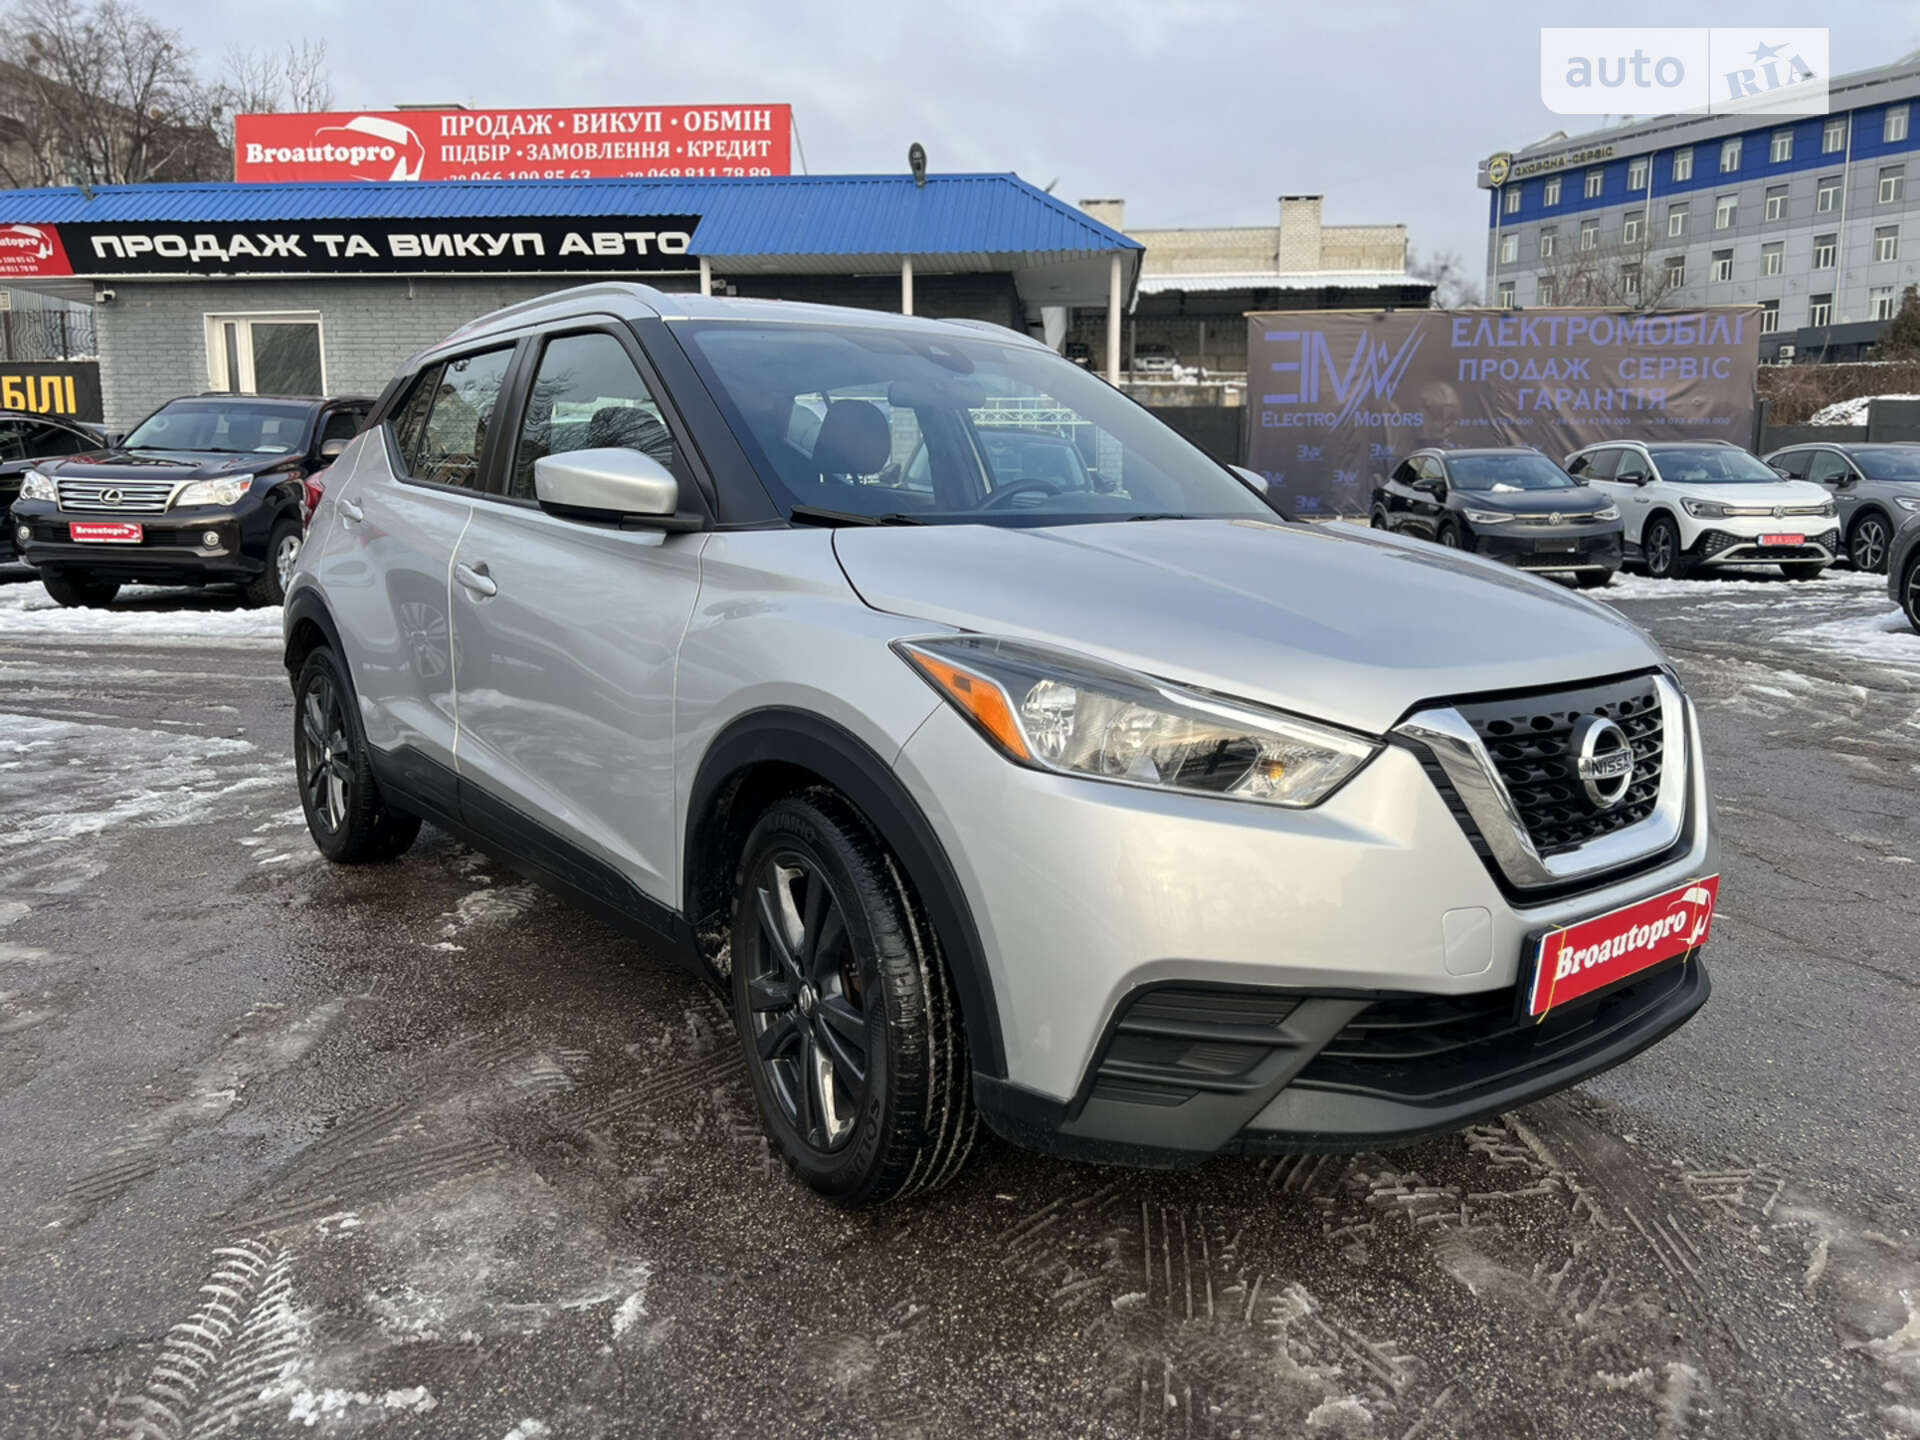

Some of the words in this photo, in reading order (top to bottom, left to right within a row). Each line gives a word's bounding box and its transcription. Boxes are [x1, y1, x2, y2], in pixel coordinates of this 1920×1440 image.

[440, 114, 553, 140] ПРОДАЖ
[572, 111, 662, 134] ВИКУП
[683, 110, 772, 133] ОБМІН
[245, 143, 396, 167] Broautopro
[440, 144, 511, 165] ПІДБІР
[526, 141, 670, 161] ЗАМОВЛЕННЯ
[687, 139, 772, 160] КРЕДИТ
[90, 234, 308, 263] ПРОДАЖ
[313, 234, 380, 258] ТА
[387, 232, 546, 257] ВИКУП
[558, 232, 693, 256] АВТО
[1450, 314, 1745, 348] ЕЛЕКТРОМОБІЛІ
[1457, 357, 1592, 382] ПРОДАЖ
[1617, 356, 1732, 380] СЕРВІС
[0, 376, 77, 414] БІЛІ
[1516, 387, 1667, 411] ГАРАНТІЯ
[1555, 909, 1687, 980] Broautopro
